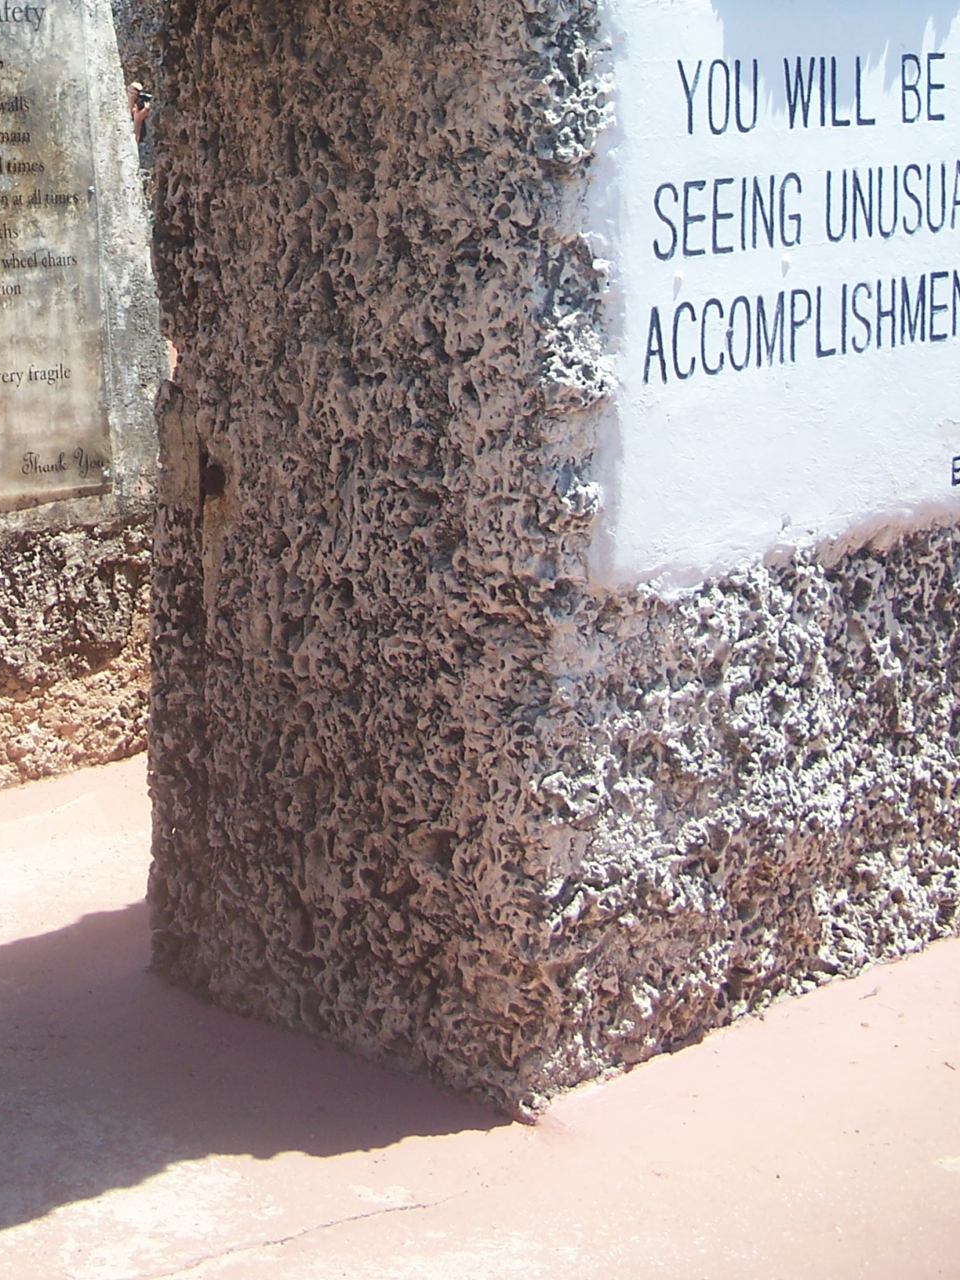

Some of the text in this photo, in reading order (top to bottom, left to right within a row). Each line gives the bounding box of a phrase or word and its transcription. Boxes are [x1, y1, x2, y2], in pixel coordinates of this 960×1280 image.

[677, 52, 947, 134] YOU WILL BE
[7, 158, 45, 173] times
[13, 194, 24, 205] at
[28, 191, 41, 205] all
[45, 191, 78, 205] times
[652, 172, 802, 262] SEEING
[1, 255, 37, 269] wheel
[42, 253, 77, 268] chairs
[28, 364, 70, 384] fragile
[21, 448, 104, 478] Thank You
